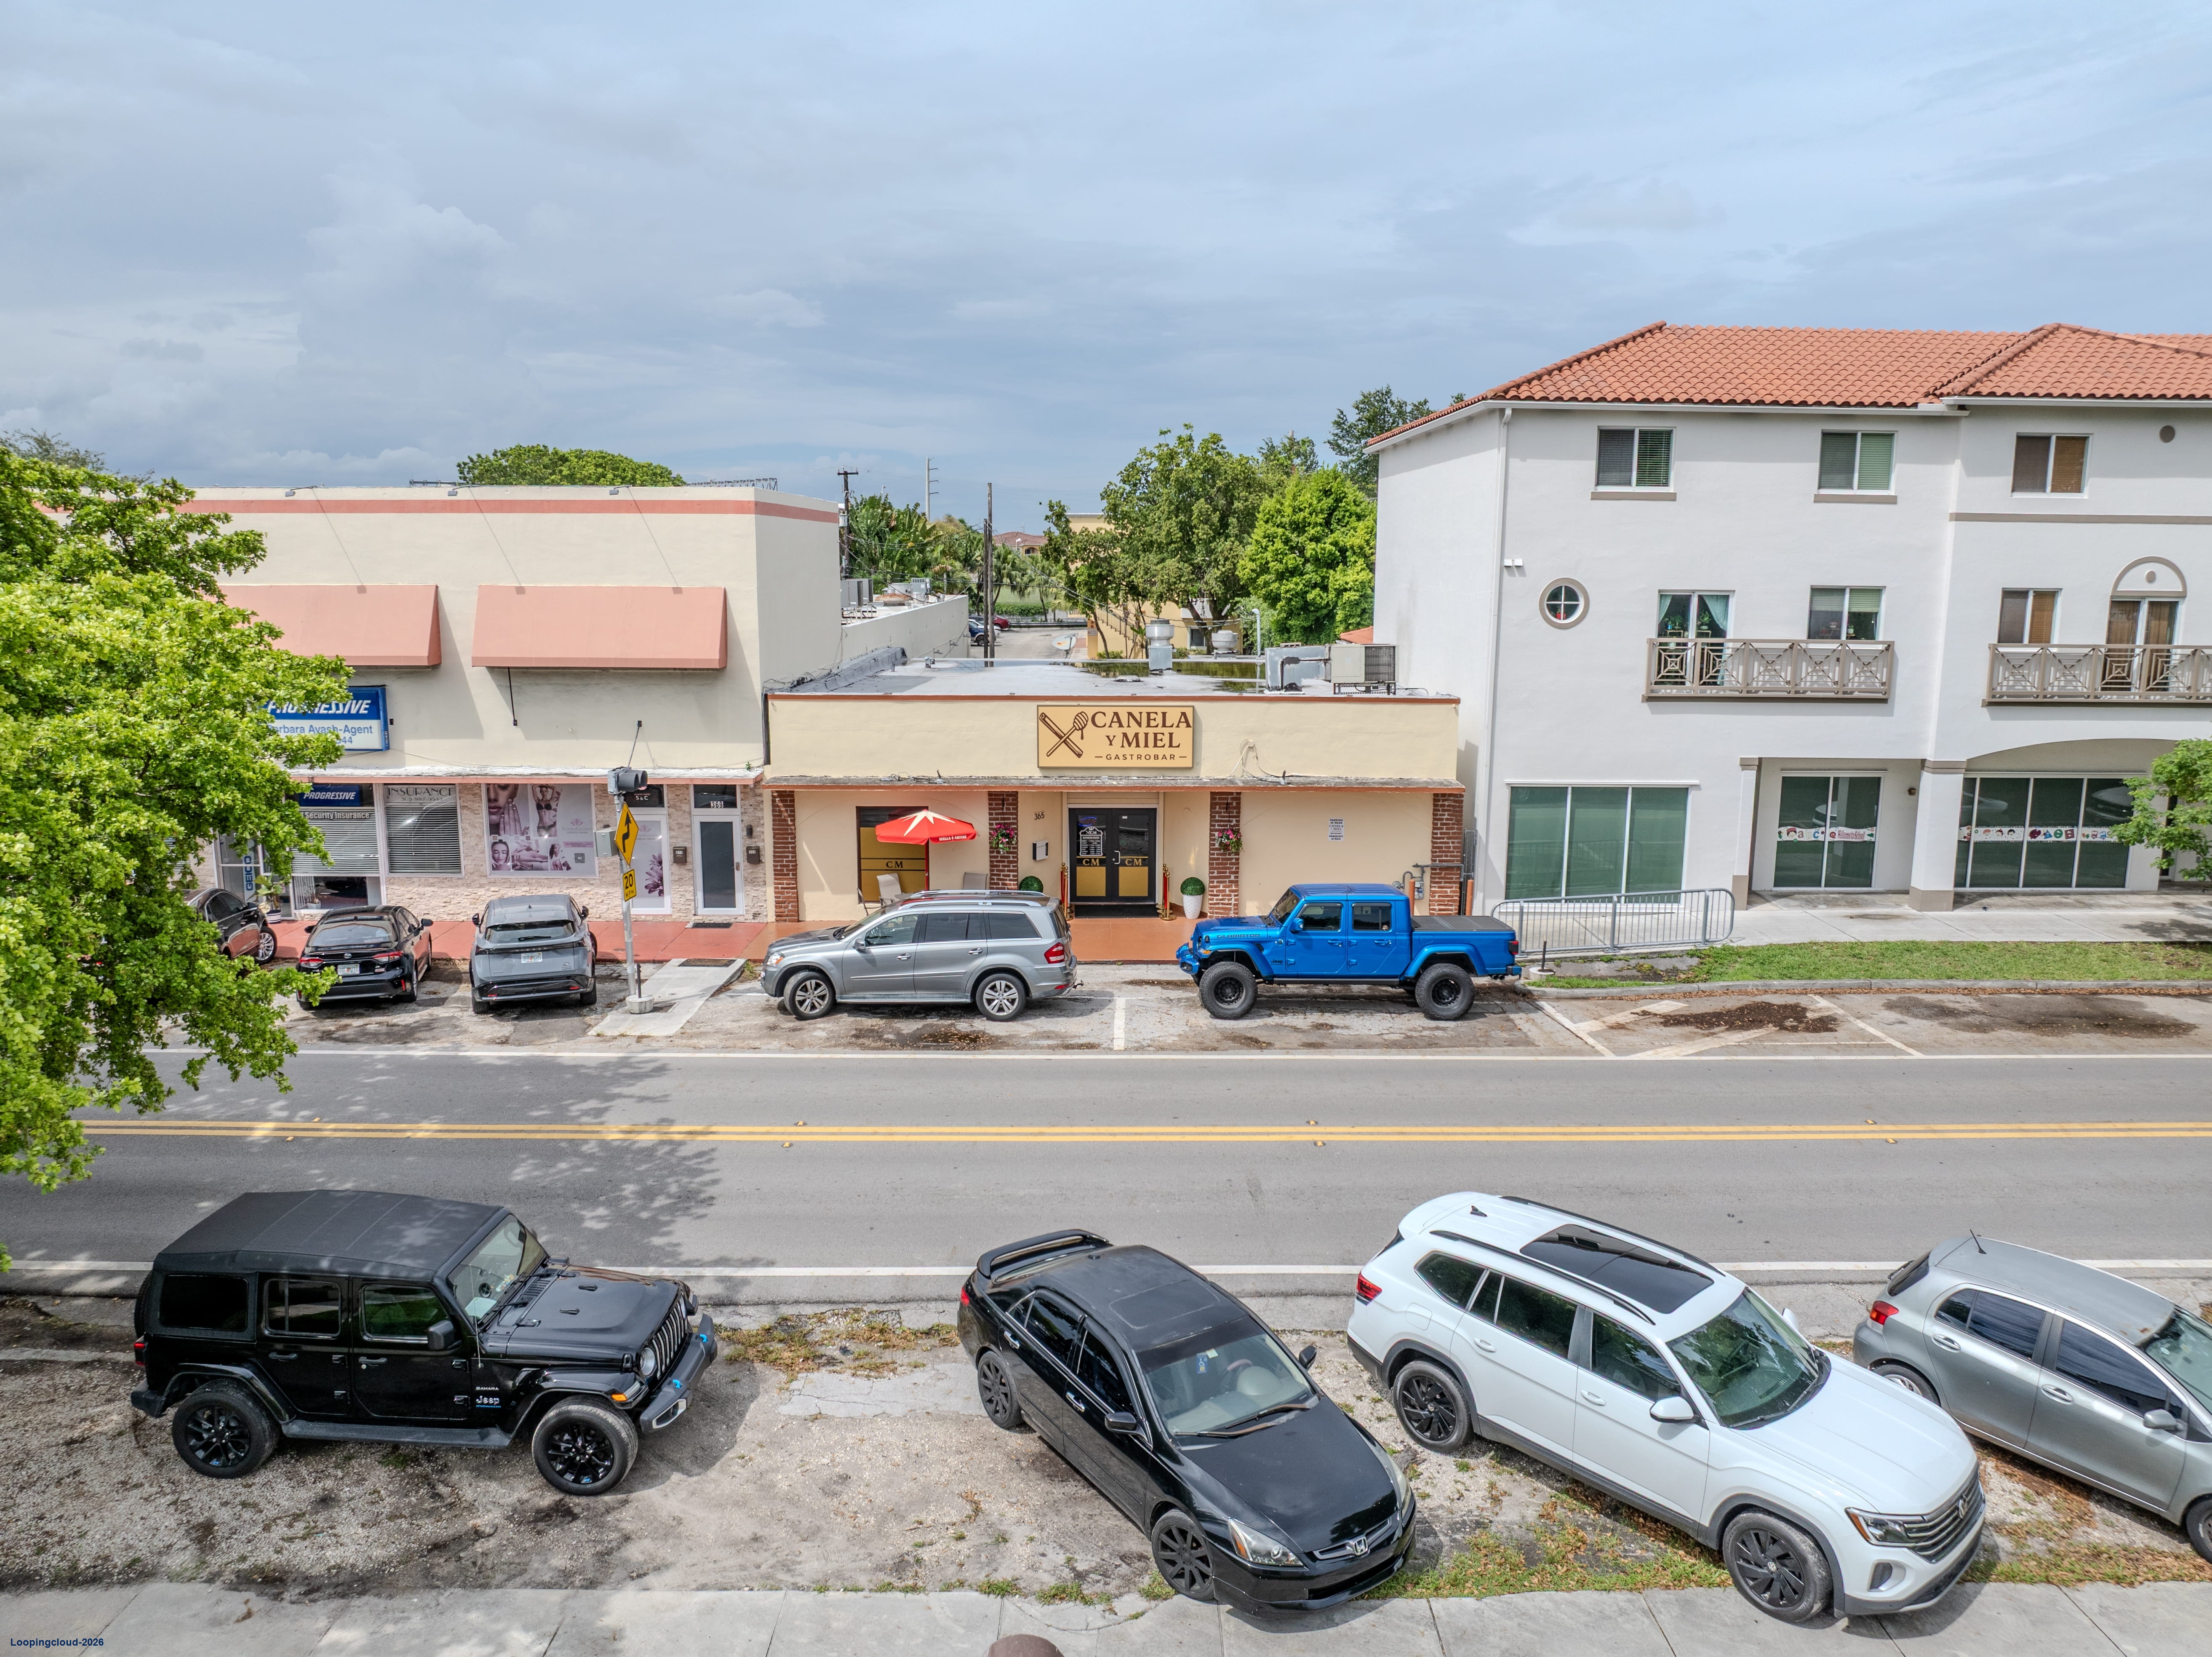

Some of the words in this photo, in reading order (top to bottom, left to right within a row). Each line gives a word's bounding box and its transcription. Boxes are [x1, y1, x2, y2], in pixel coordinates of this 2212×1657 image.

[267, 700, 371, 714] PRORESSIVE
[1091, 711, 1192, 728] CANELA
[1105, 735, 1116, 746] Y
[1121, 732, 1181, 748] MIEL
[388, 788, 456, 796] INSURANCE
[305, 811, 334, 820] Security
[1034, 812, 1045, 820] 365
[244, 855, 254, 891] GEICO
[624, 873, 634, 890] 20
[475, 1395, 500, 1406] Jeep
